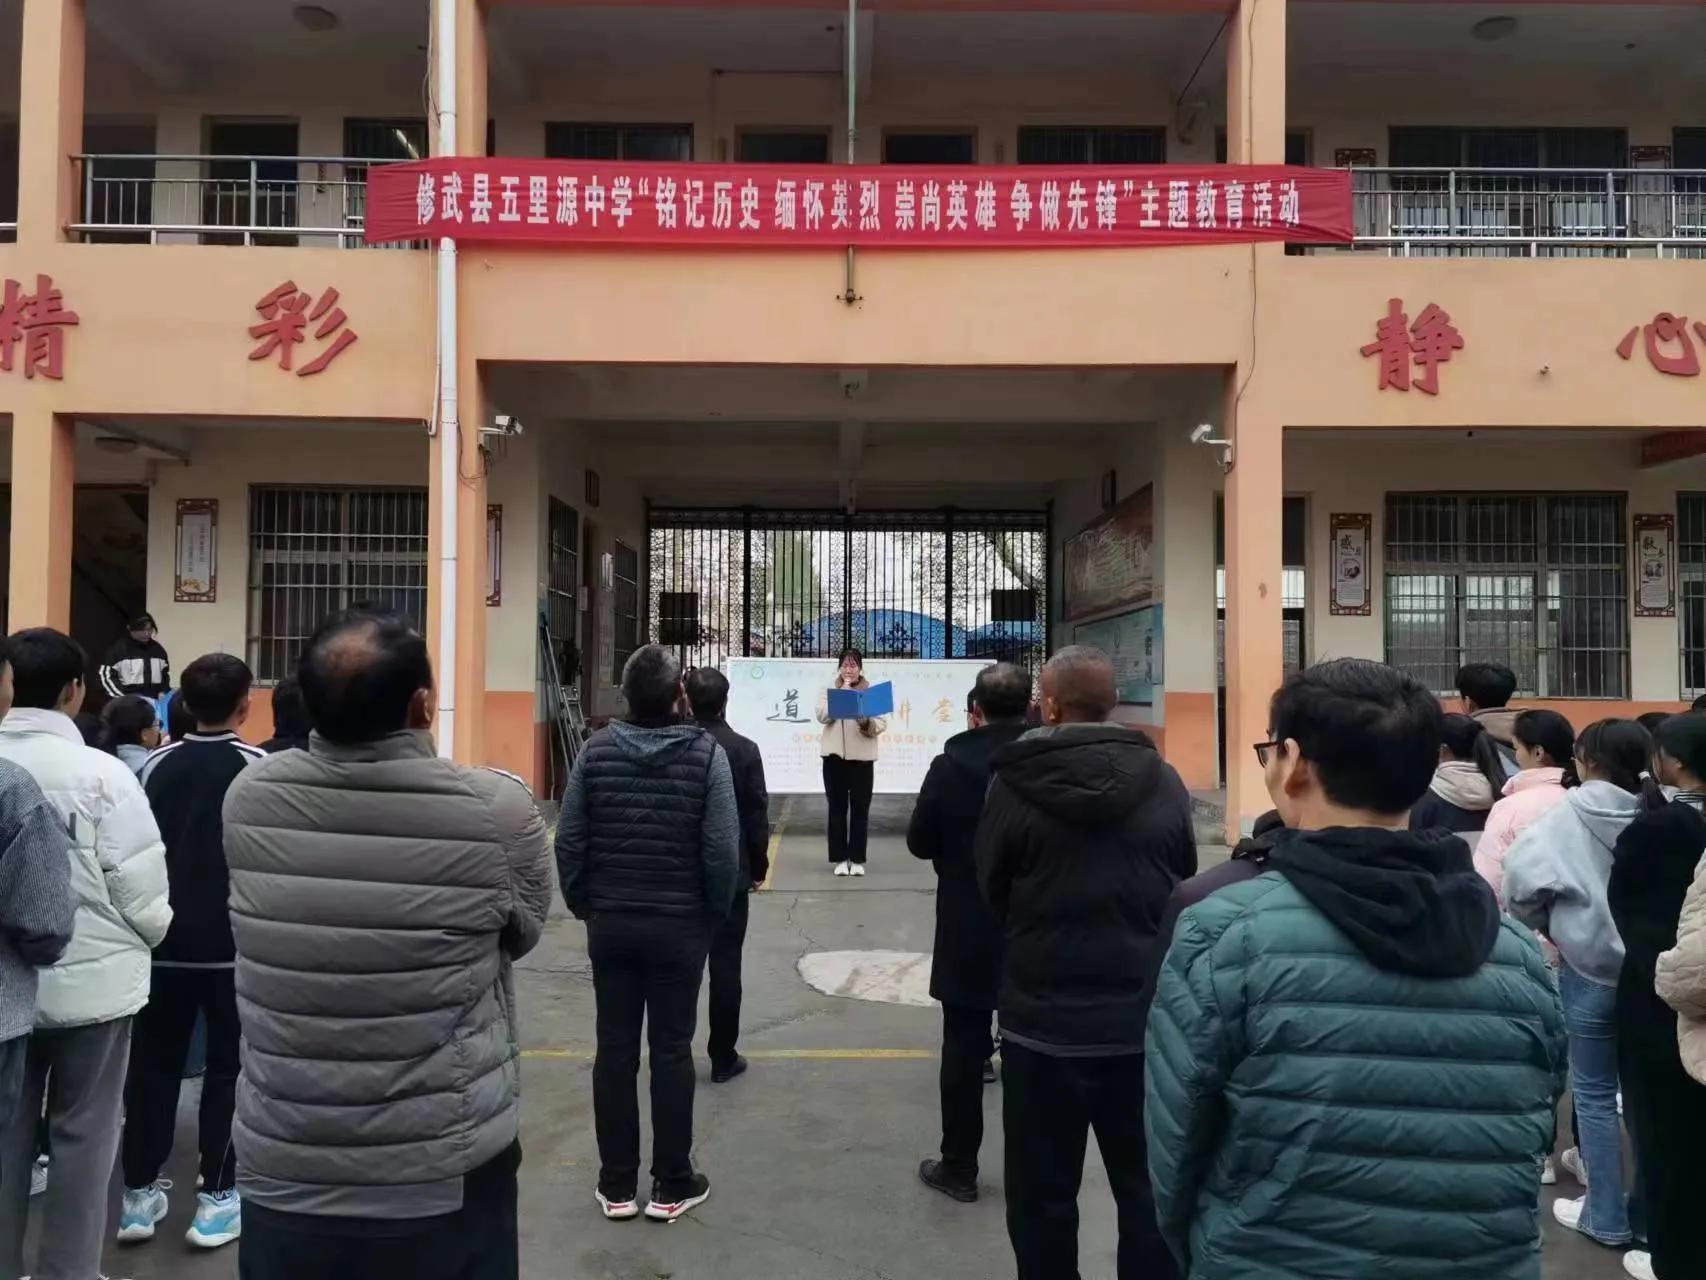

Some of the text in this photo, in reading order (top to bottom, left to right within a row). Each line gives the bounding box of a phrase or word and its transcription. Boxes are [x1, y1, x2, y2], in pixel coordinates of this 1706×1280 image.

[774, 178, 881, 231] 缅怀英烈
[894, 178, 997, 231] 崇尚英雄
[0, 273, 358, 379] 精 彩
[1360, 297, 1706, 395] 静 心
[766, 688, 811, 723] 道
